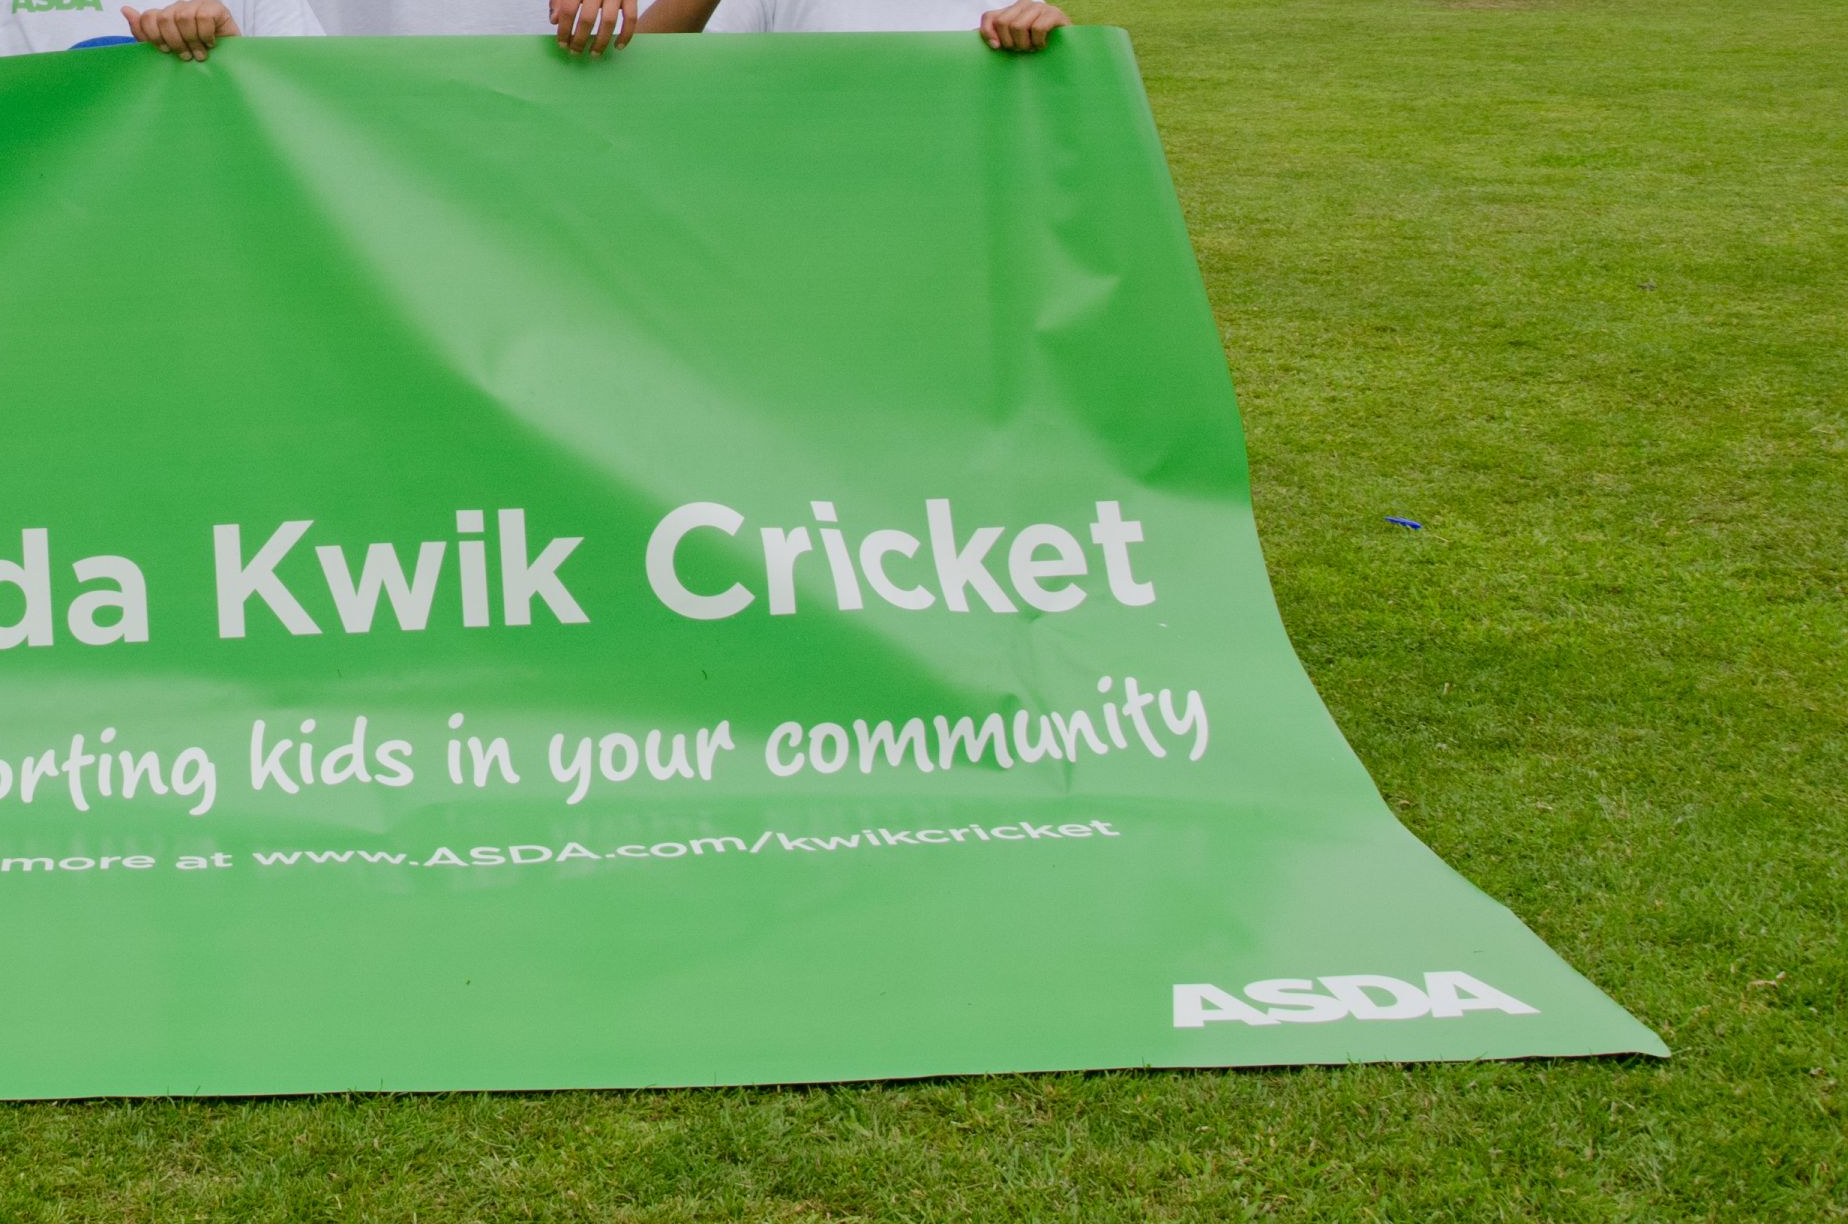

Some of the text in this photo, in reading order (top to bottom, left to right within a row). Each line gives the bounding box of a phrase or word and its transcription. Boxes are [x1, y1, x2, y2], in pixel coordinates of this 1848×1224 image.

[213, 508, 590, 638] Kwik
[645, 498, 1156, 619] Cricket
[251, 715, 413, 794] kids
[447, 712, 519, 786] in
[548, 719, 734, 804] your
[764, 675, 1208, 776] community
[1, 854, 156, 871] more
[174, 850, 233, 869] at
[252, 819, 1119, 866] www.ASDA.com/kwikcricket
[1173, 970, 1541, 1027] ASDA
